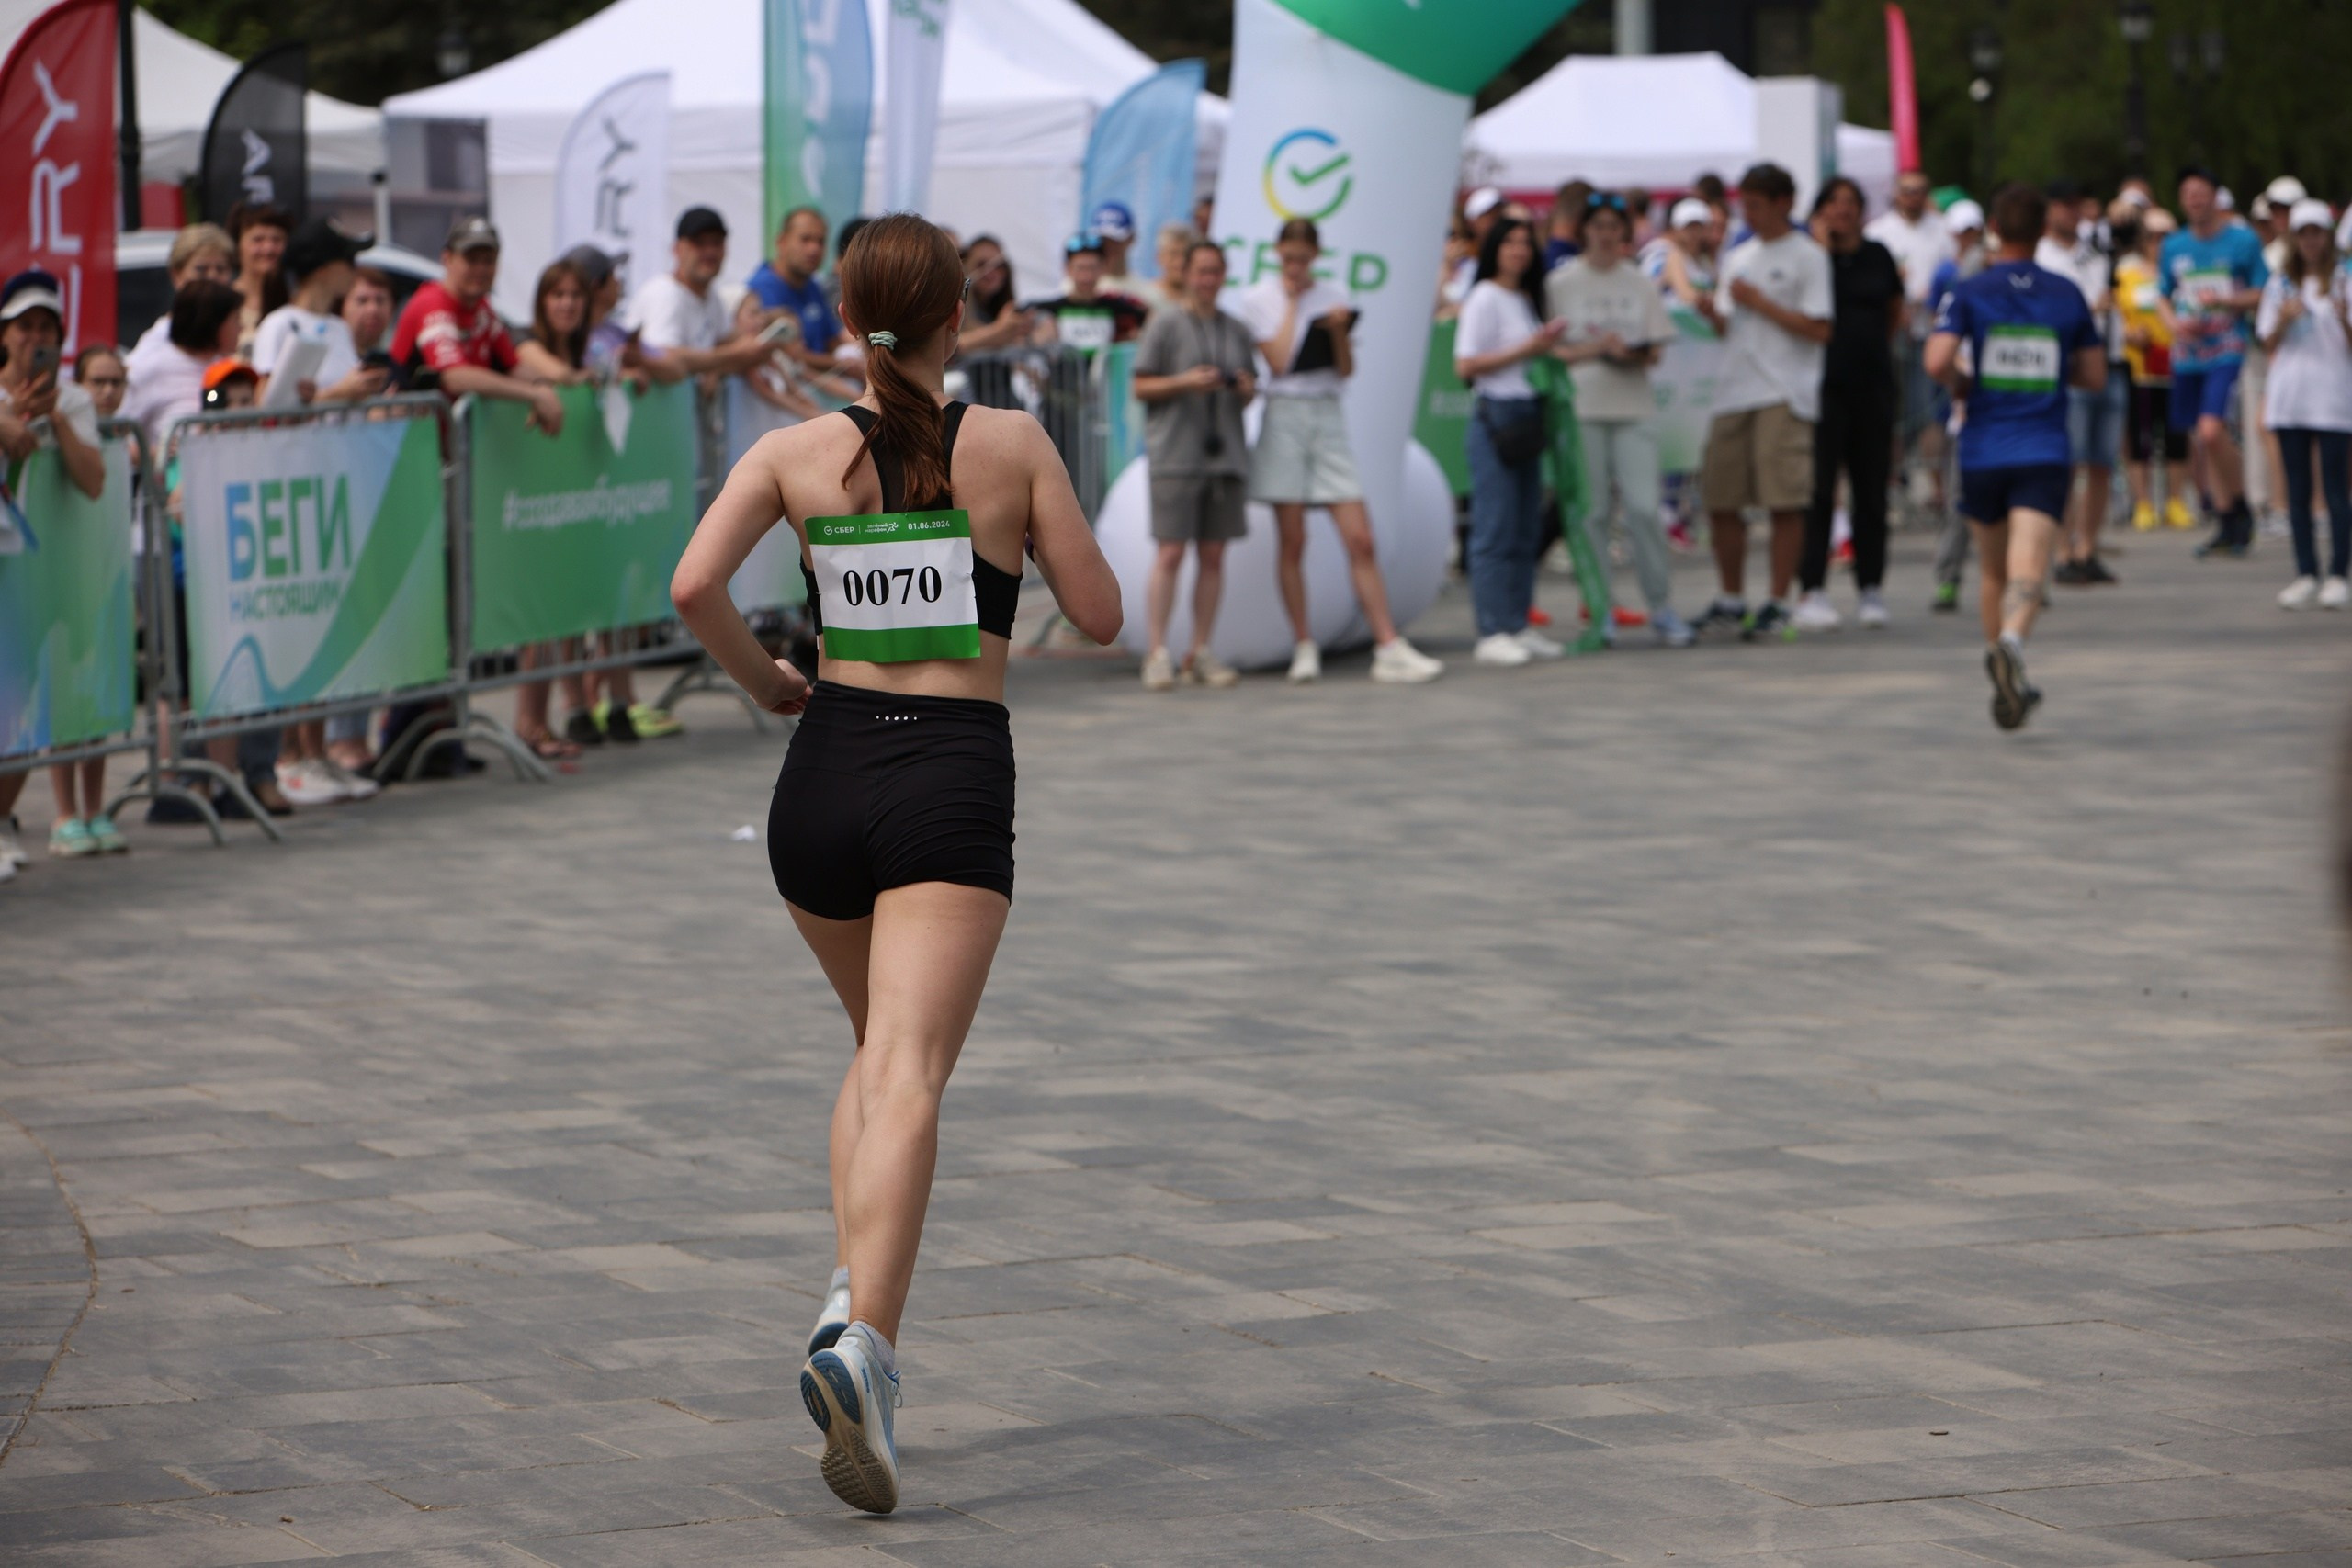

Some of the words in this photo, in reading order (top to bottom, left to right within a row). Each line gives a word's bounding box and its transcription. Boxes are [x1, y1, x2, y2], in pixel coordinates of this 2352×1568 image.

[224, 472, 353, 581] БЕГИ
[834, 525, 855, 534] СБЕР
[908, 520, 951, 531] 01.06.2024
[842, 565, 943, 607] 0070
